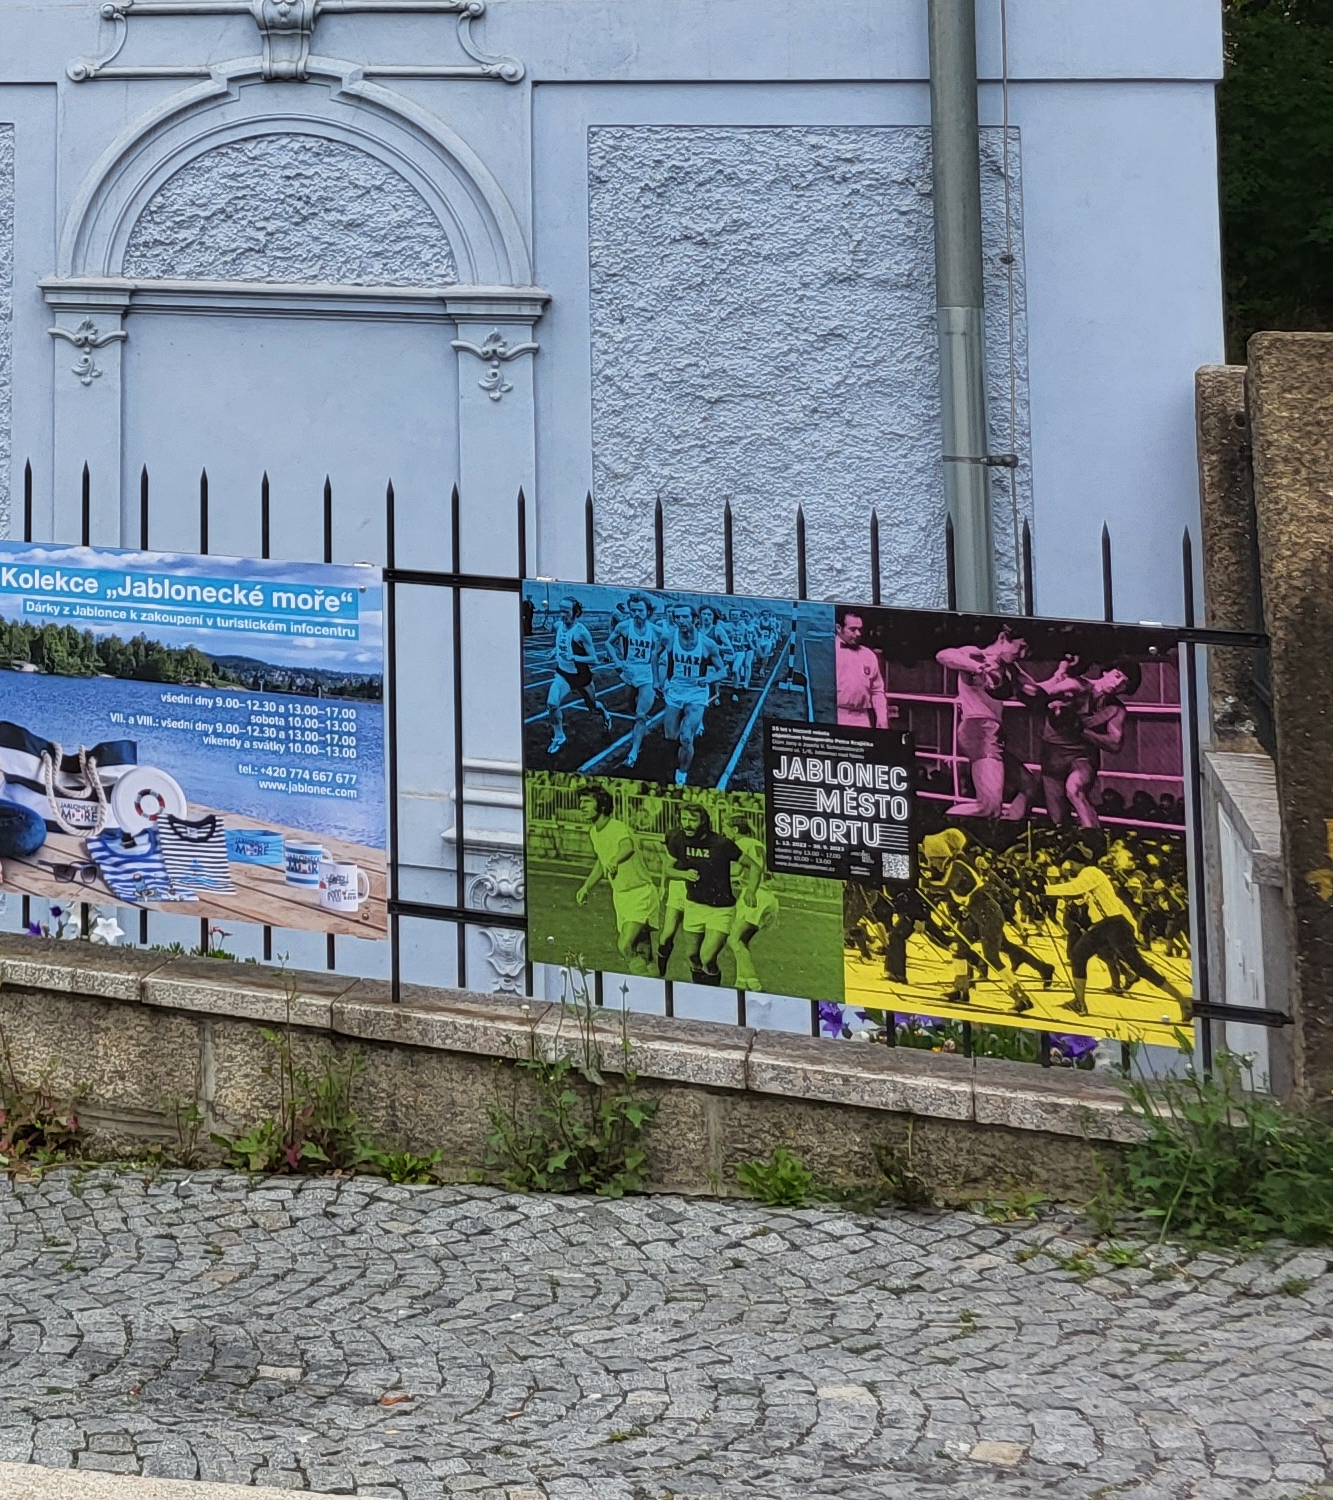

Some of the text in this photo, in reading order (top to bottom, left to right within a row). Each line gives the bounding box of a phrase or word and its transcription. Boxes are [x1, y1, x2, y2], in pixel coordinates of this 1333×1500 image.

[1, 566, 99, 594] Kolekce
[26, 601, 356, 637] Dárky z Jablonce k zakoupení v turistickém infocentru
[161, 692, 193, 705] všední
[195, 695, 213, 708] dny
[279, 705, 285, 713] a
[128, 716, 134, 724] a
[161, 717, 193, 731] všední
[195, 721, 214, 734] dny
[279, 731, 285, 739] a
[250, 714, 285, 726] sobota
[203, 735, 241, 749] víkendy
[244, 740, 250, 748] a
[253, 740, 285, 754] svátky
[238, 764, 357, 785] tel.: +420 774 667 677
[773, 755, 908, 792] JABLONEC
[259, 780, 358, 798] www.jablonec.com
[816, 786, 908, 820] MĚSTO
[774, 812, 880, 847] SPORTU
